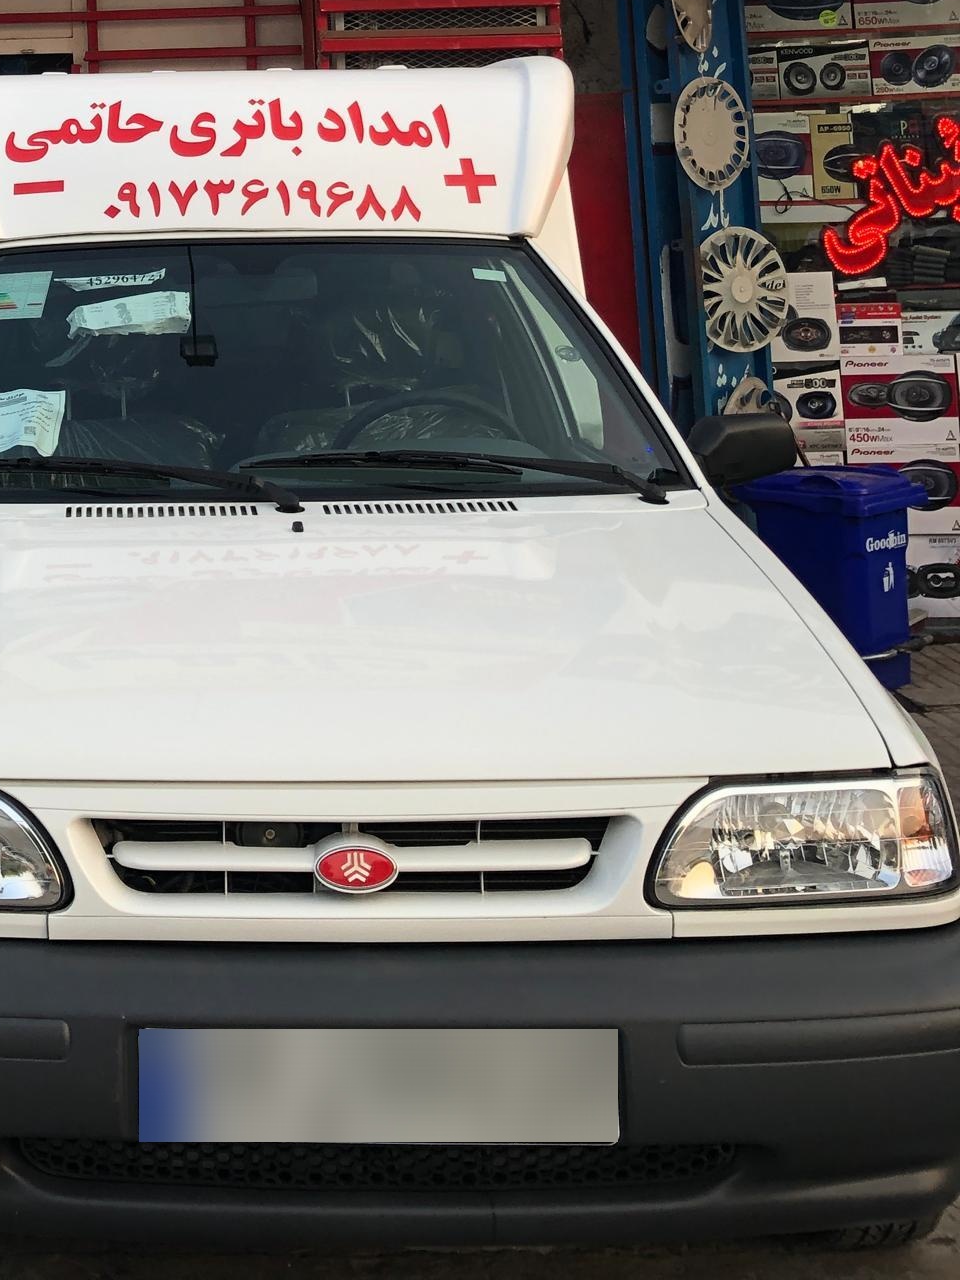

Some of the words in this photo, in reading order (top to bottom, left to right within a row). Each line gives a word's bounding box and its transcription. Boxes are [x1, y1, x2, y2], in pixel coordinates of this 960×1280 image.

[780, 47, 814, 56] KENWOOD
[873, 40, 912, 49] Pioneer
[4, 99, 164, 164] حاتمی
[169, 96, 304, 157] باتری
[316, 99, 452, 150] امداد
[102, 178, 423, 223] ۰۹۱۷۳۶۱۹۶۸۸
[844, 360, 889, 368] Pioneer
[850, 448, 895, 456] Pioneer
